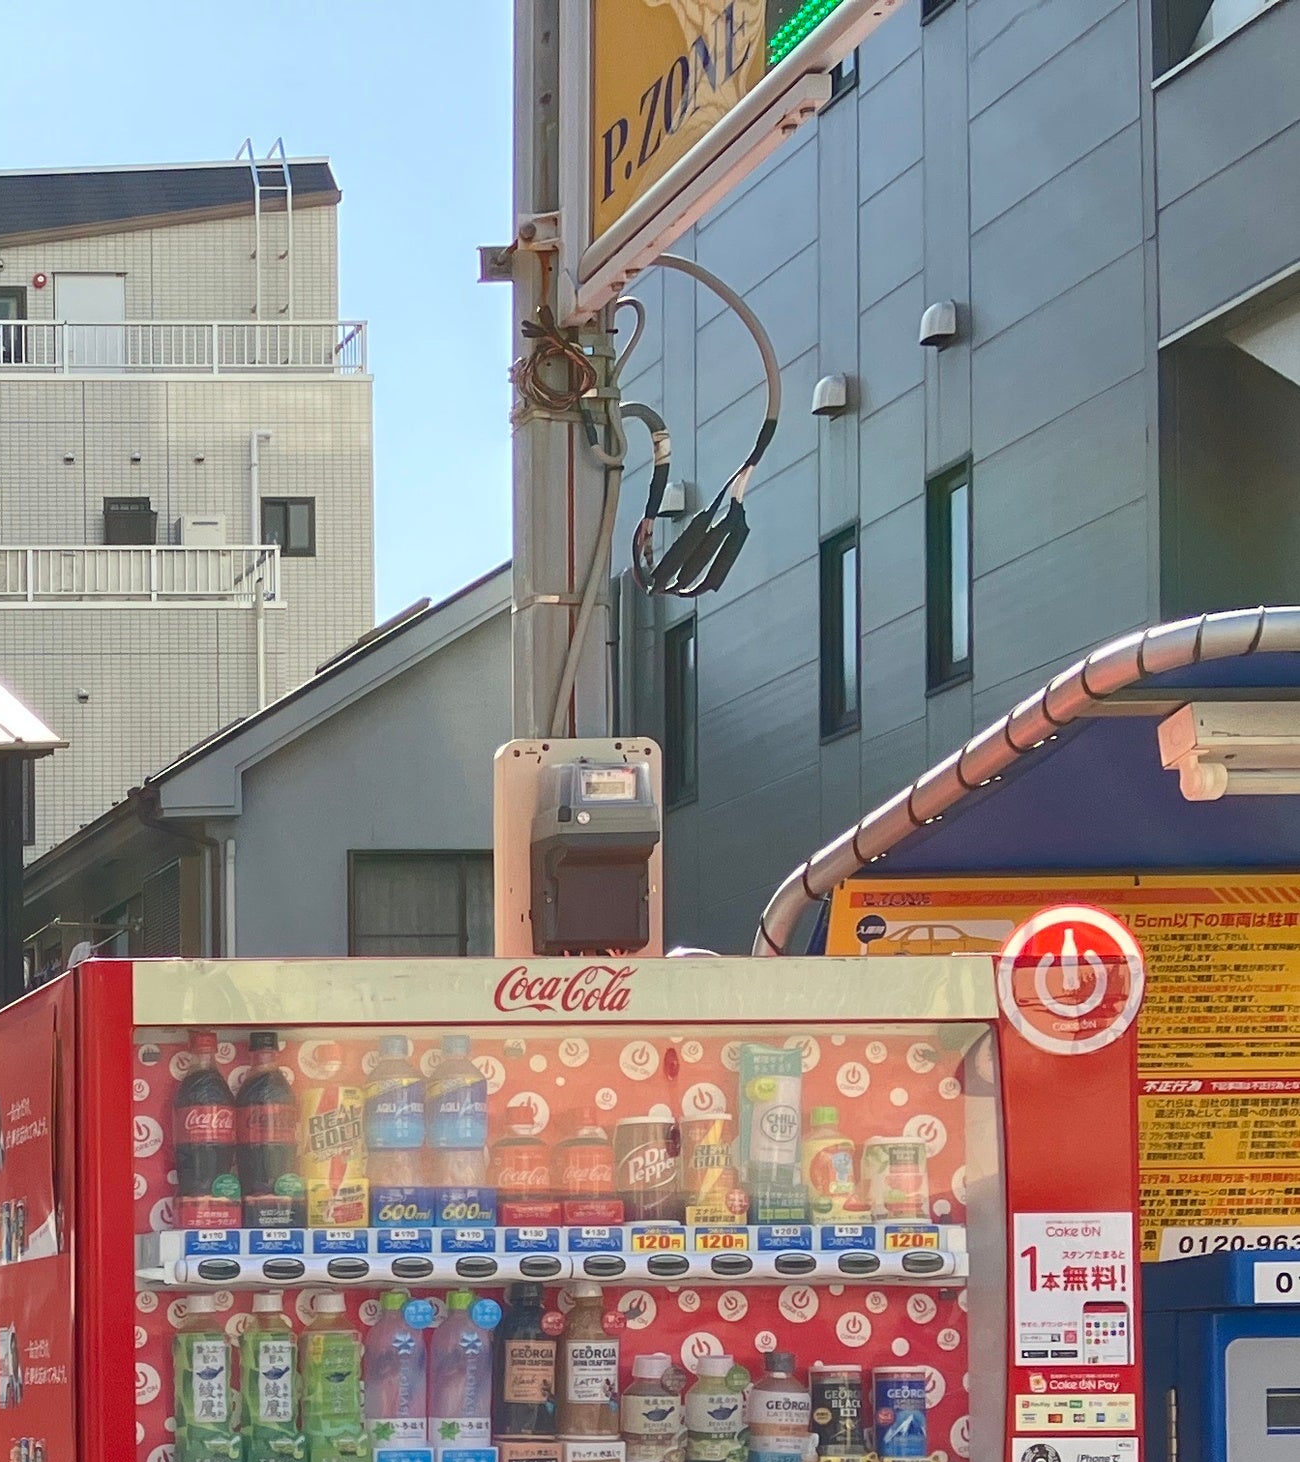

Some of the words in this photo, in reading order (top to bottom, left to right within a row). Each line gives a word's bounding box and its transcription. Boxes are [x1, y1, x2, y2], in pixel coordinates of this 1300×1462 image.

[601, 2, 754, 204] P.ZONE
[493, 965, 639, 1013] Coca-Cola
[185, 1108, 234, 1131] Coca-Cola
[308, 1105, 361, 1132] REAL
[766, 1113, 797, 1126] CHILL
[310, 1121, 362, 1149] GOLD
[771, 1125, 793, 1135] OUT
[379, 1204, 431, 1221] 600ml
[442, 1204, 493, 1221] 600ml
[1046, 1226, 1078, 1237] Coke
[1081, 1225, 1101, 1237] ON
[636, 1235, 681, 1249] 120円
[700, 1235, 744, 1249] 120円
[890, 1233, 936, 1249] 120円
[1062, 1251, 1125, 1259] スタンプたまると
[572, 1347, 617, 1359] GEORGIA
[1049, 1380, 1079, 1391] Coke
[1098, 1380, 1120, 1393] Pay
